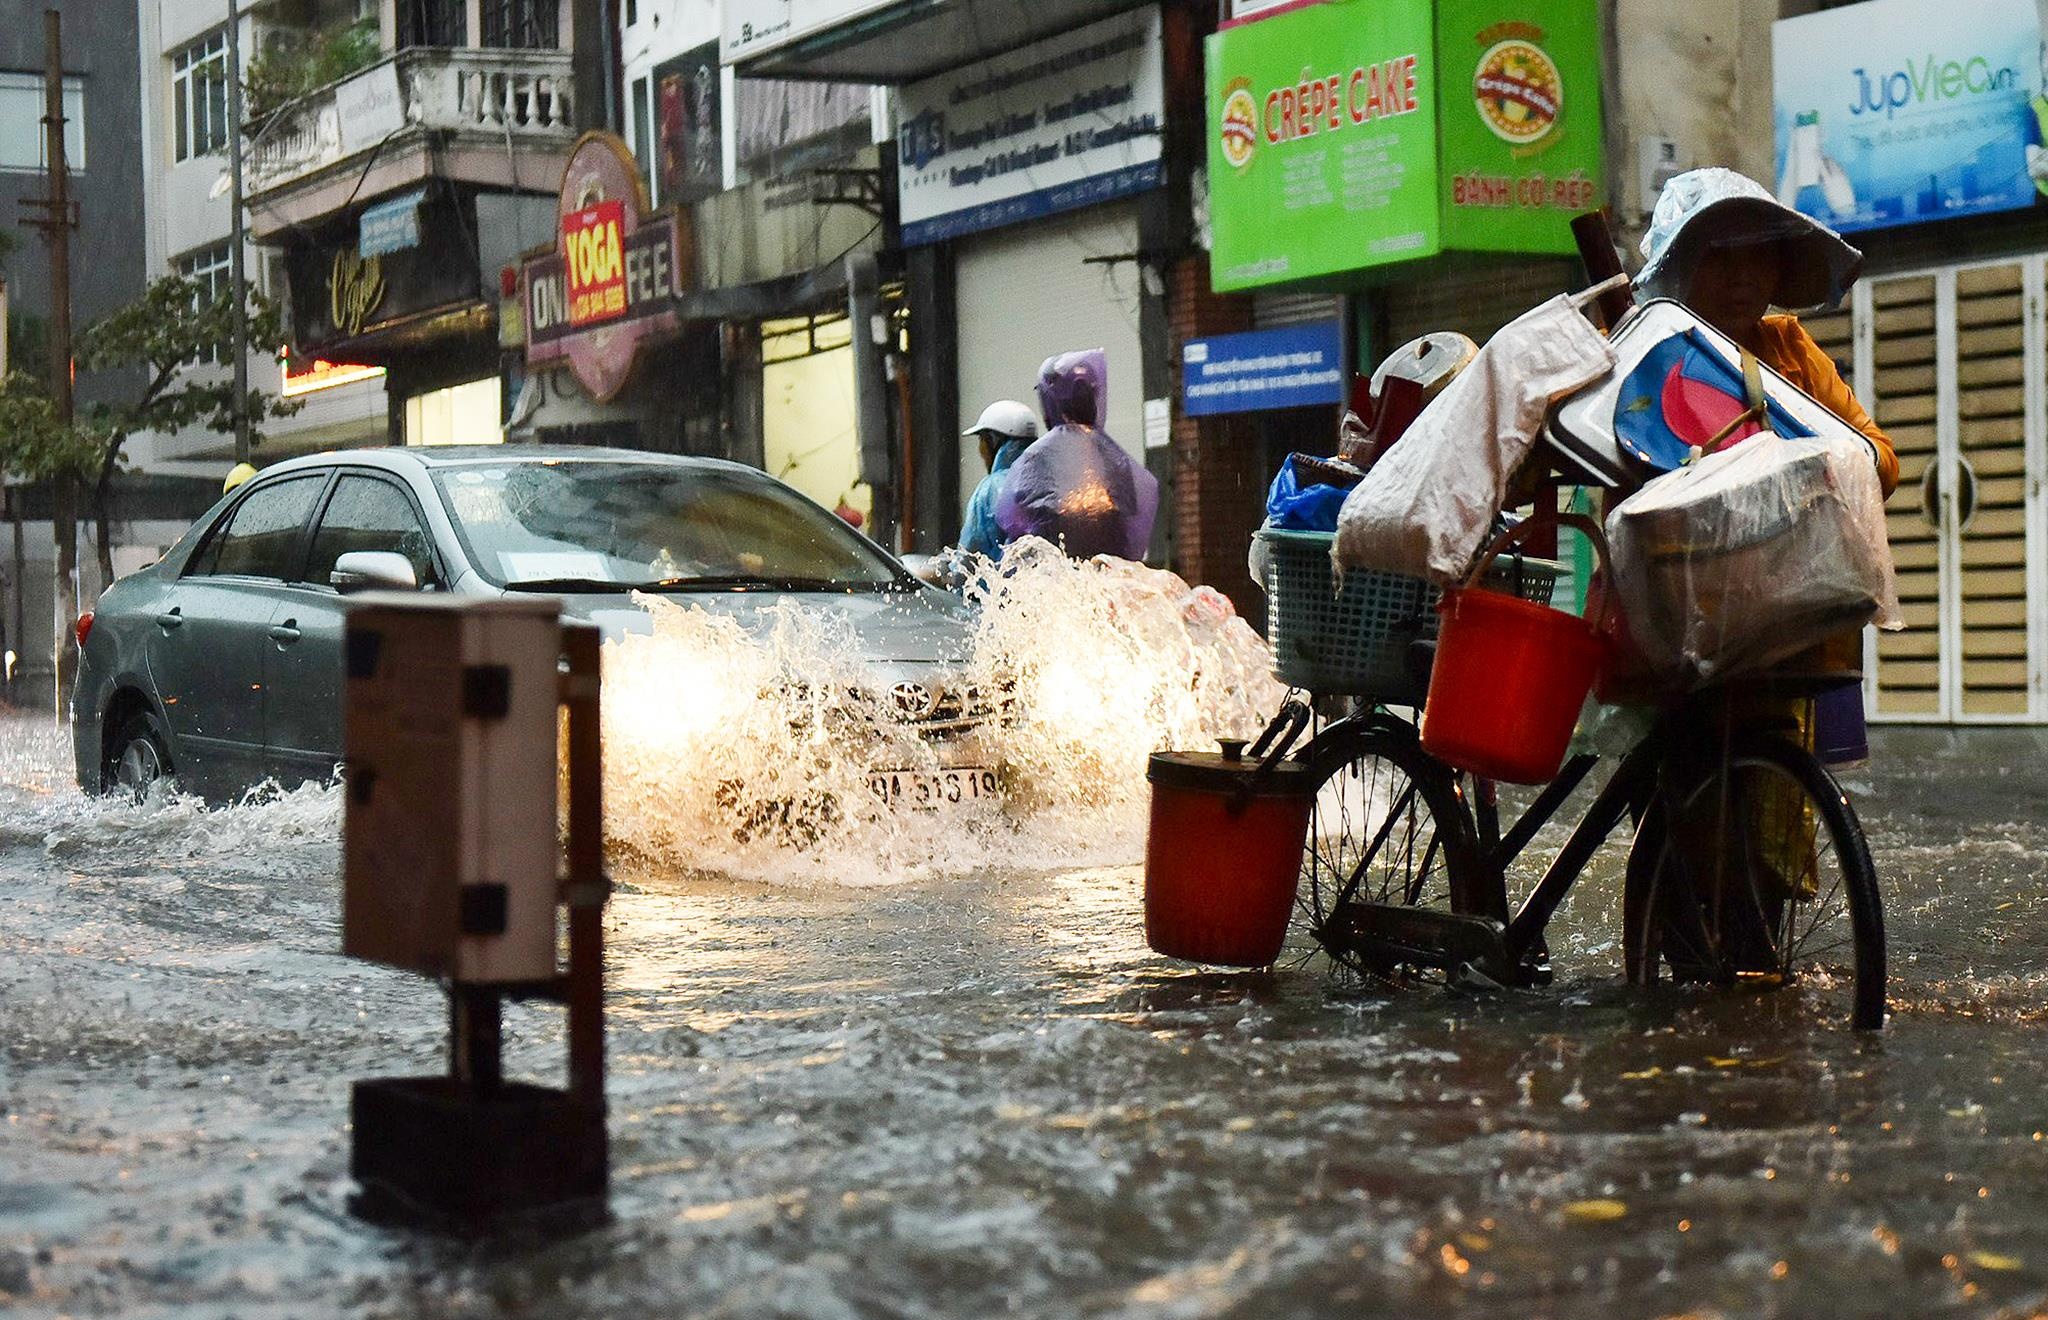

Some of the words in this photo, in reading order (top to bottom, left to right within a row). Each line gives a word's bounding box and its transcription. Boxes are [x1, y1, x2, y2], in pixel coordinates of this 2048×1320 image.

[1347, 54, 1417, 126] CAKE
[1452, 166, 1513, 207] BÁNH
[566, 219, 622, 290] YOGA
